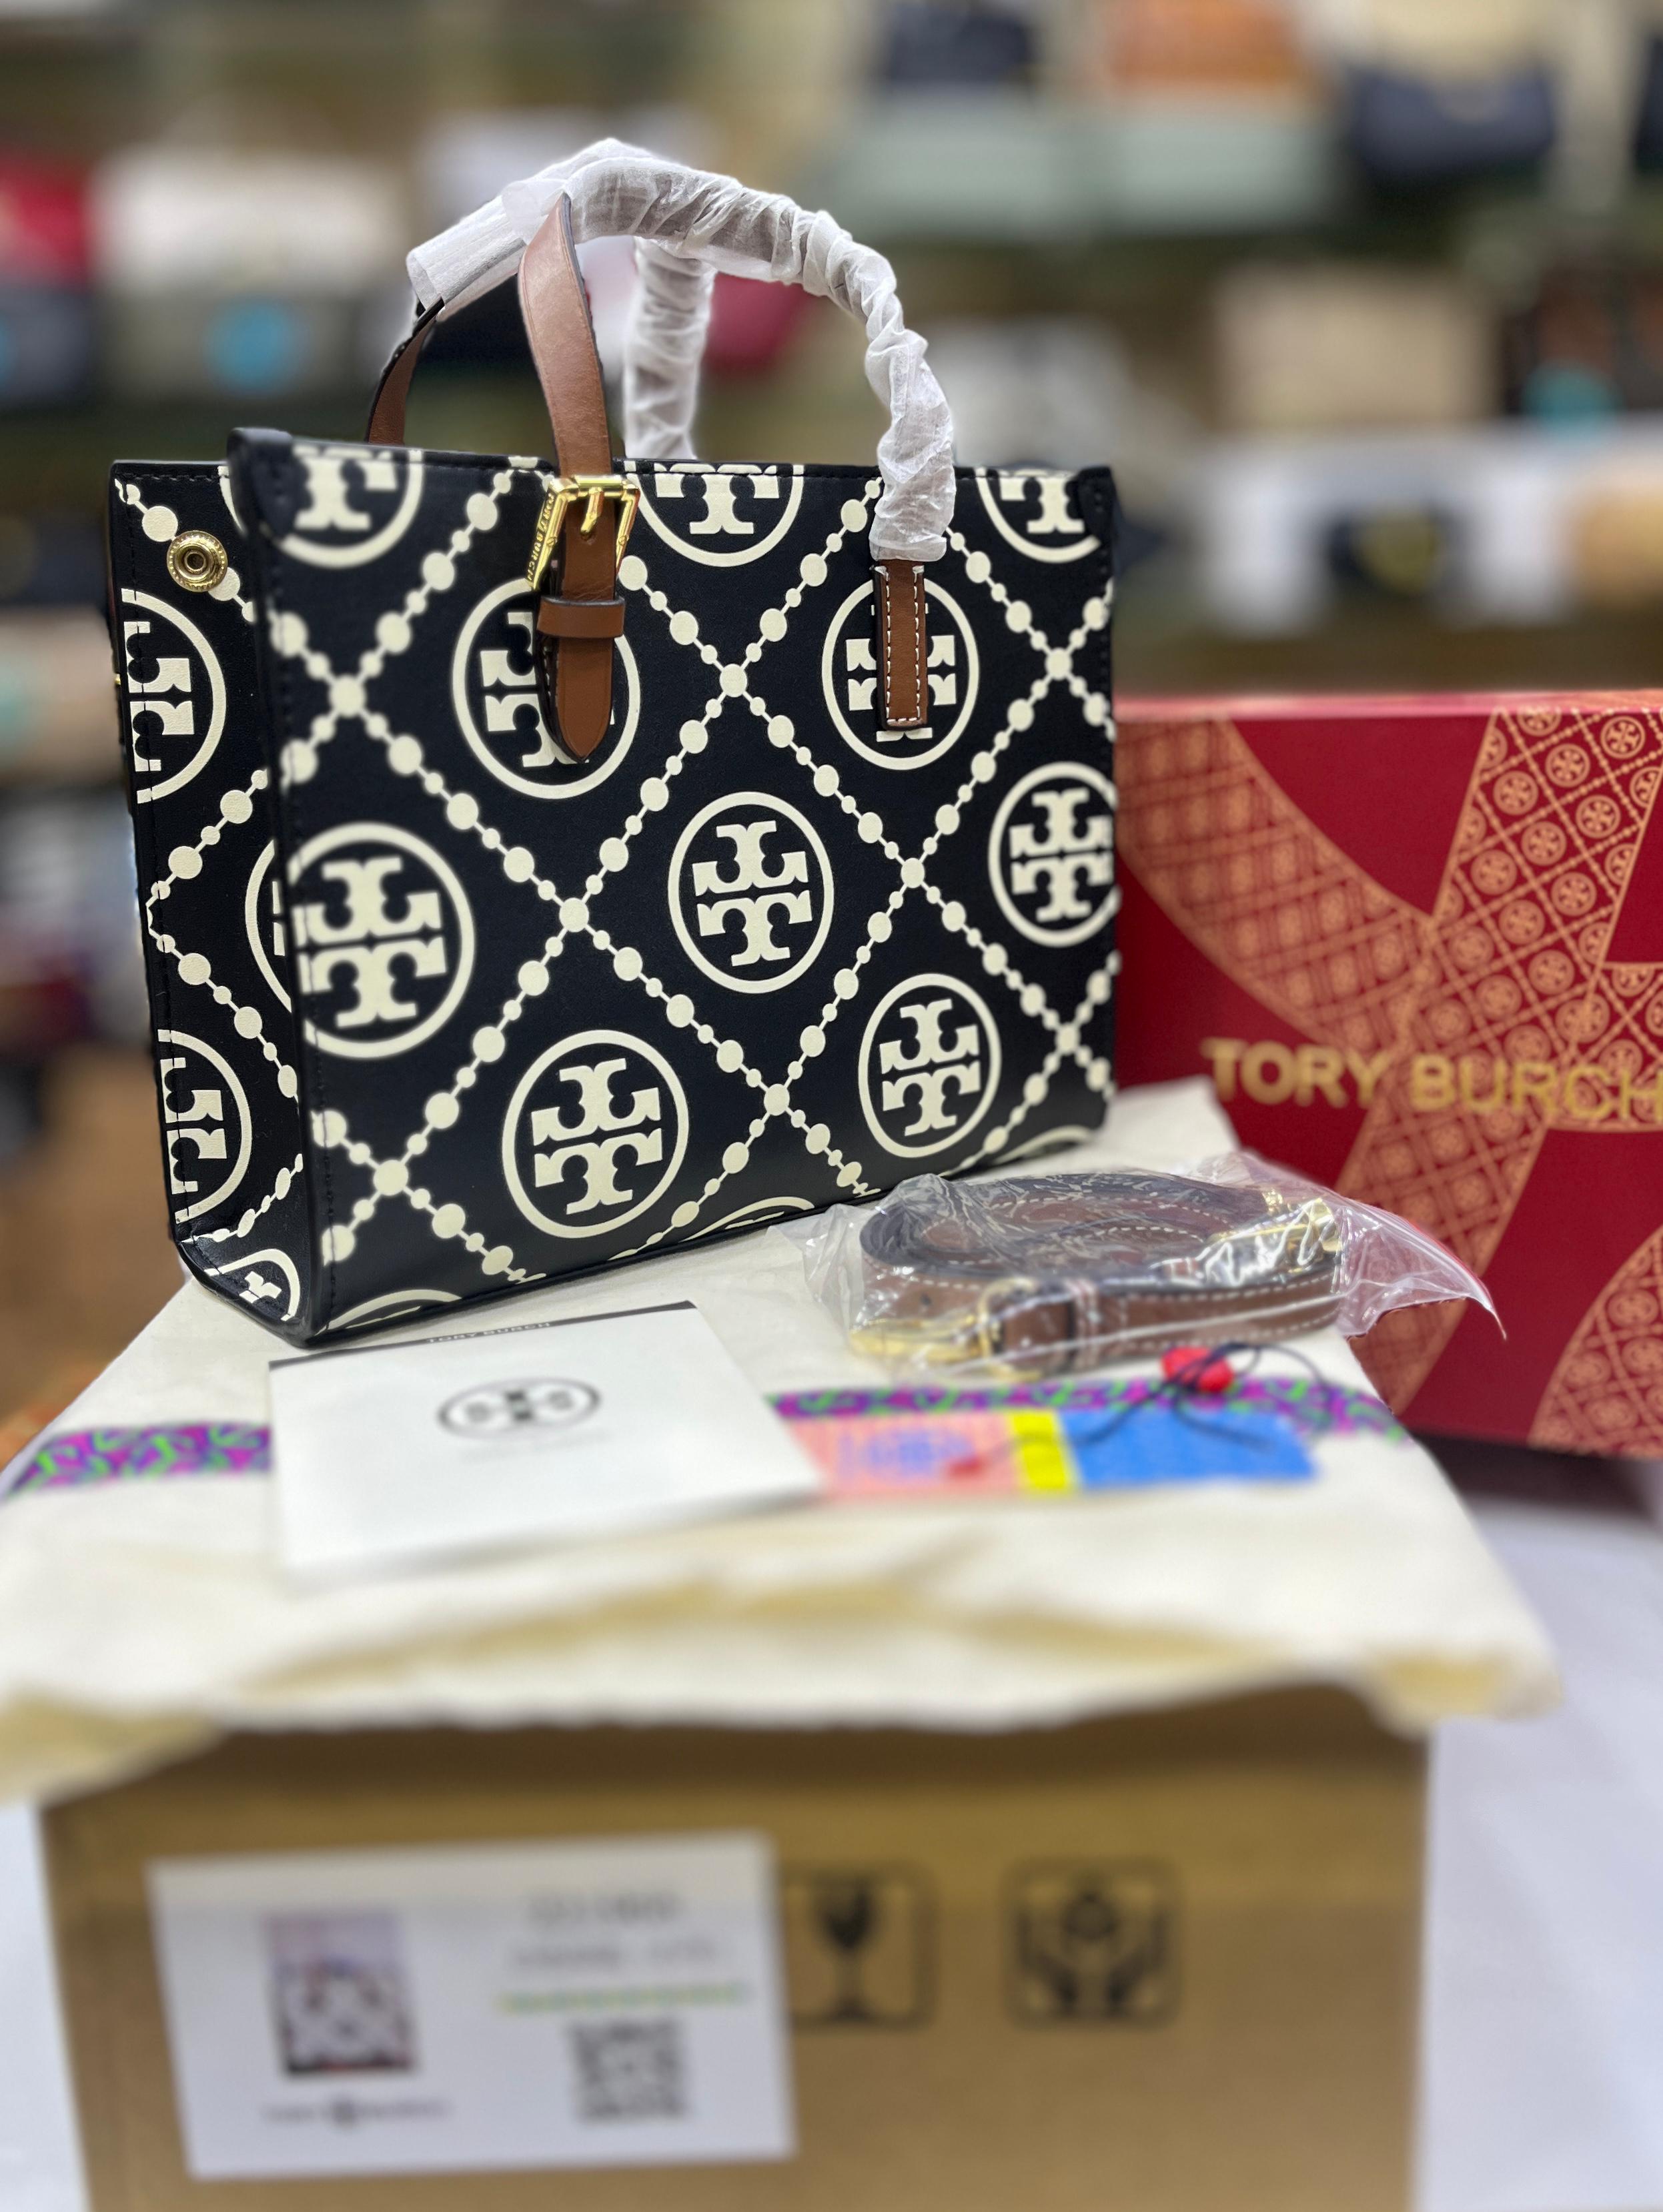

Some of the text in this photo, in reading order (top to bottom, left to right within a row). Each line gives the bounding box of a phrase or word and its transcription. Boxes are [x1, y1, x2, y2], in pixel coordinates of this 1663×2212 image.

[1202, 1039, 1663, 1121] TORY BURCH
[427, 1323, 550, 1343] TORY BURCH
